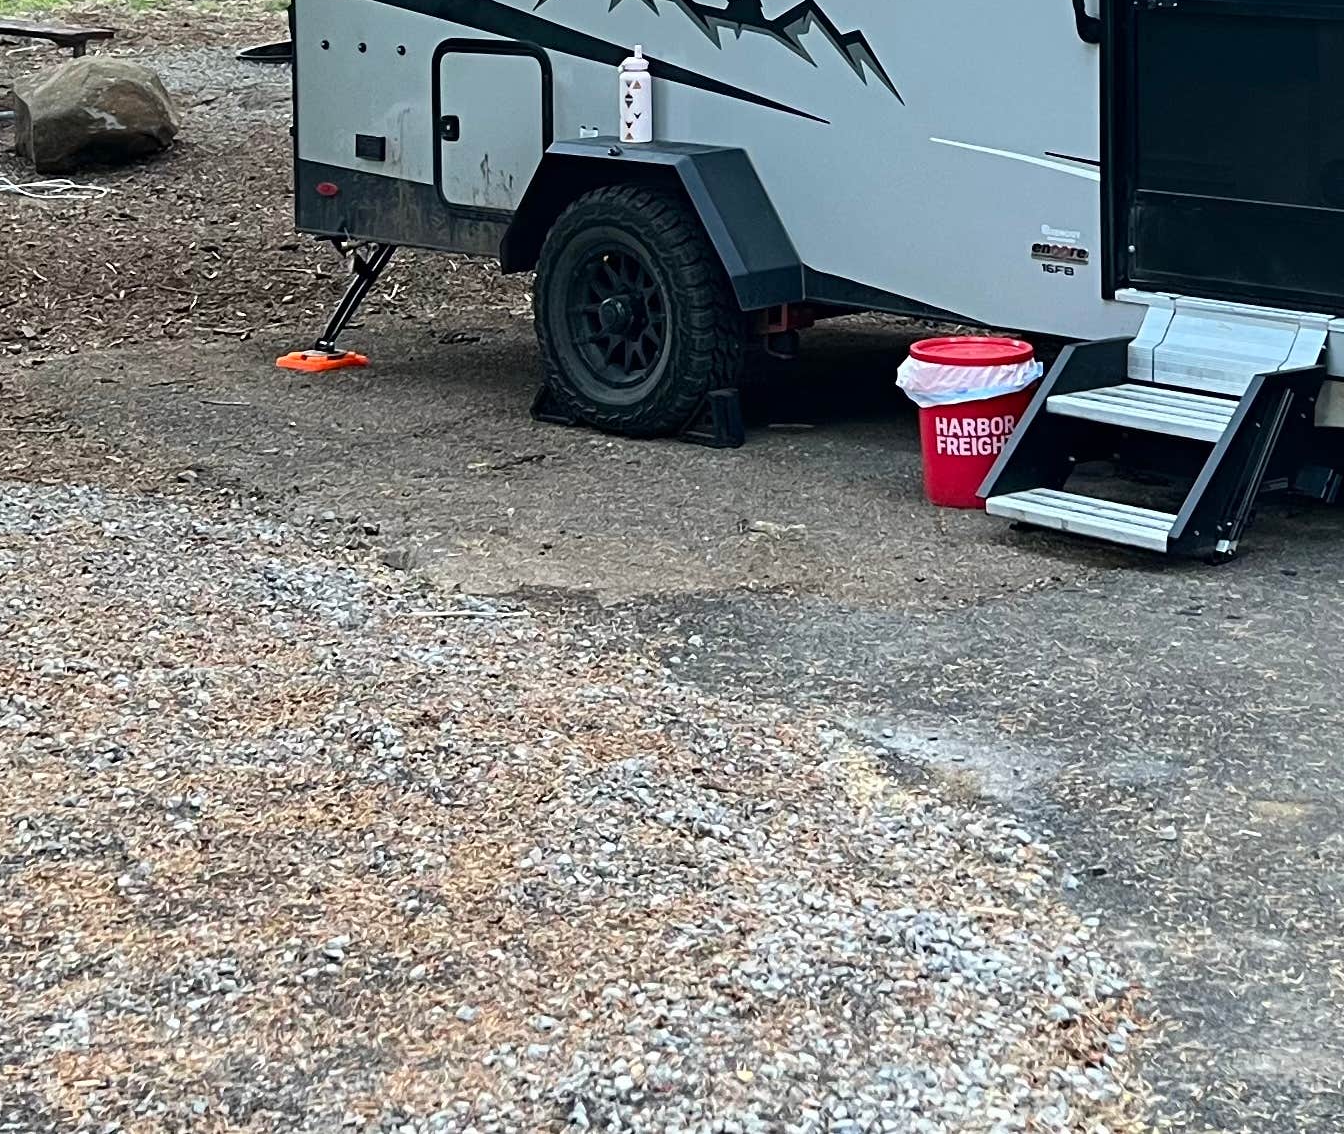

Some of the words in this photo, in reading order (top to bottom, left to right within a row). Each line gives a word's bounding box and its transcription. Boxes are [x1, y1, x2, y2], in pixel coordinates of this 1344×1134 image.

[1041, 263, 1075, 276] 16FB
[935, 415, 1016, 437] HARBOR
[936, 435, 1010, 456] FREIGH
